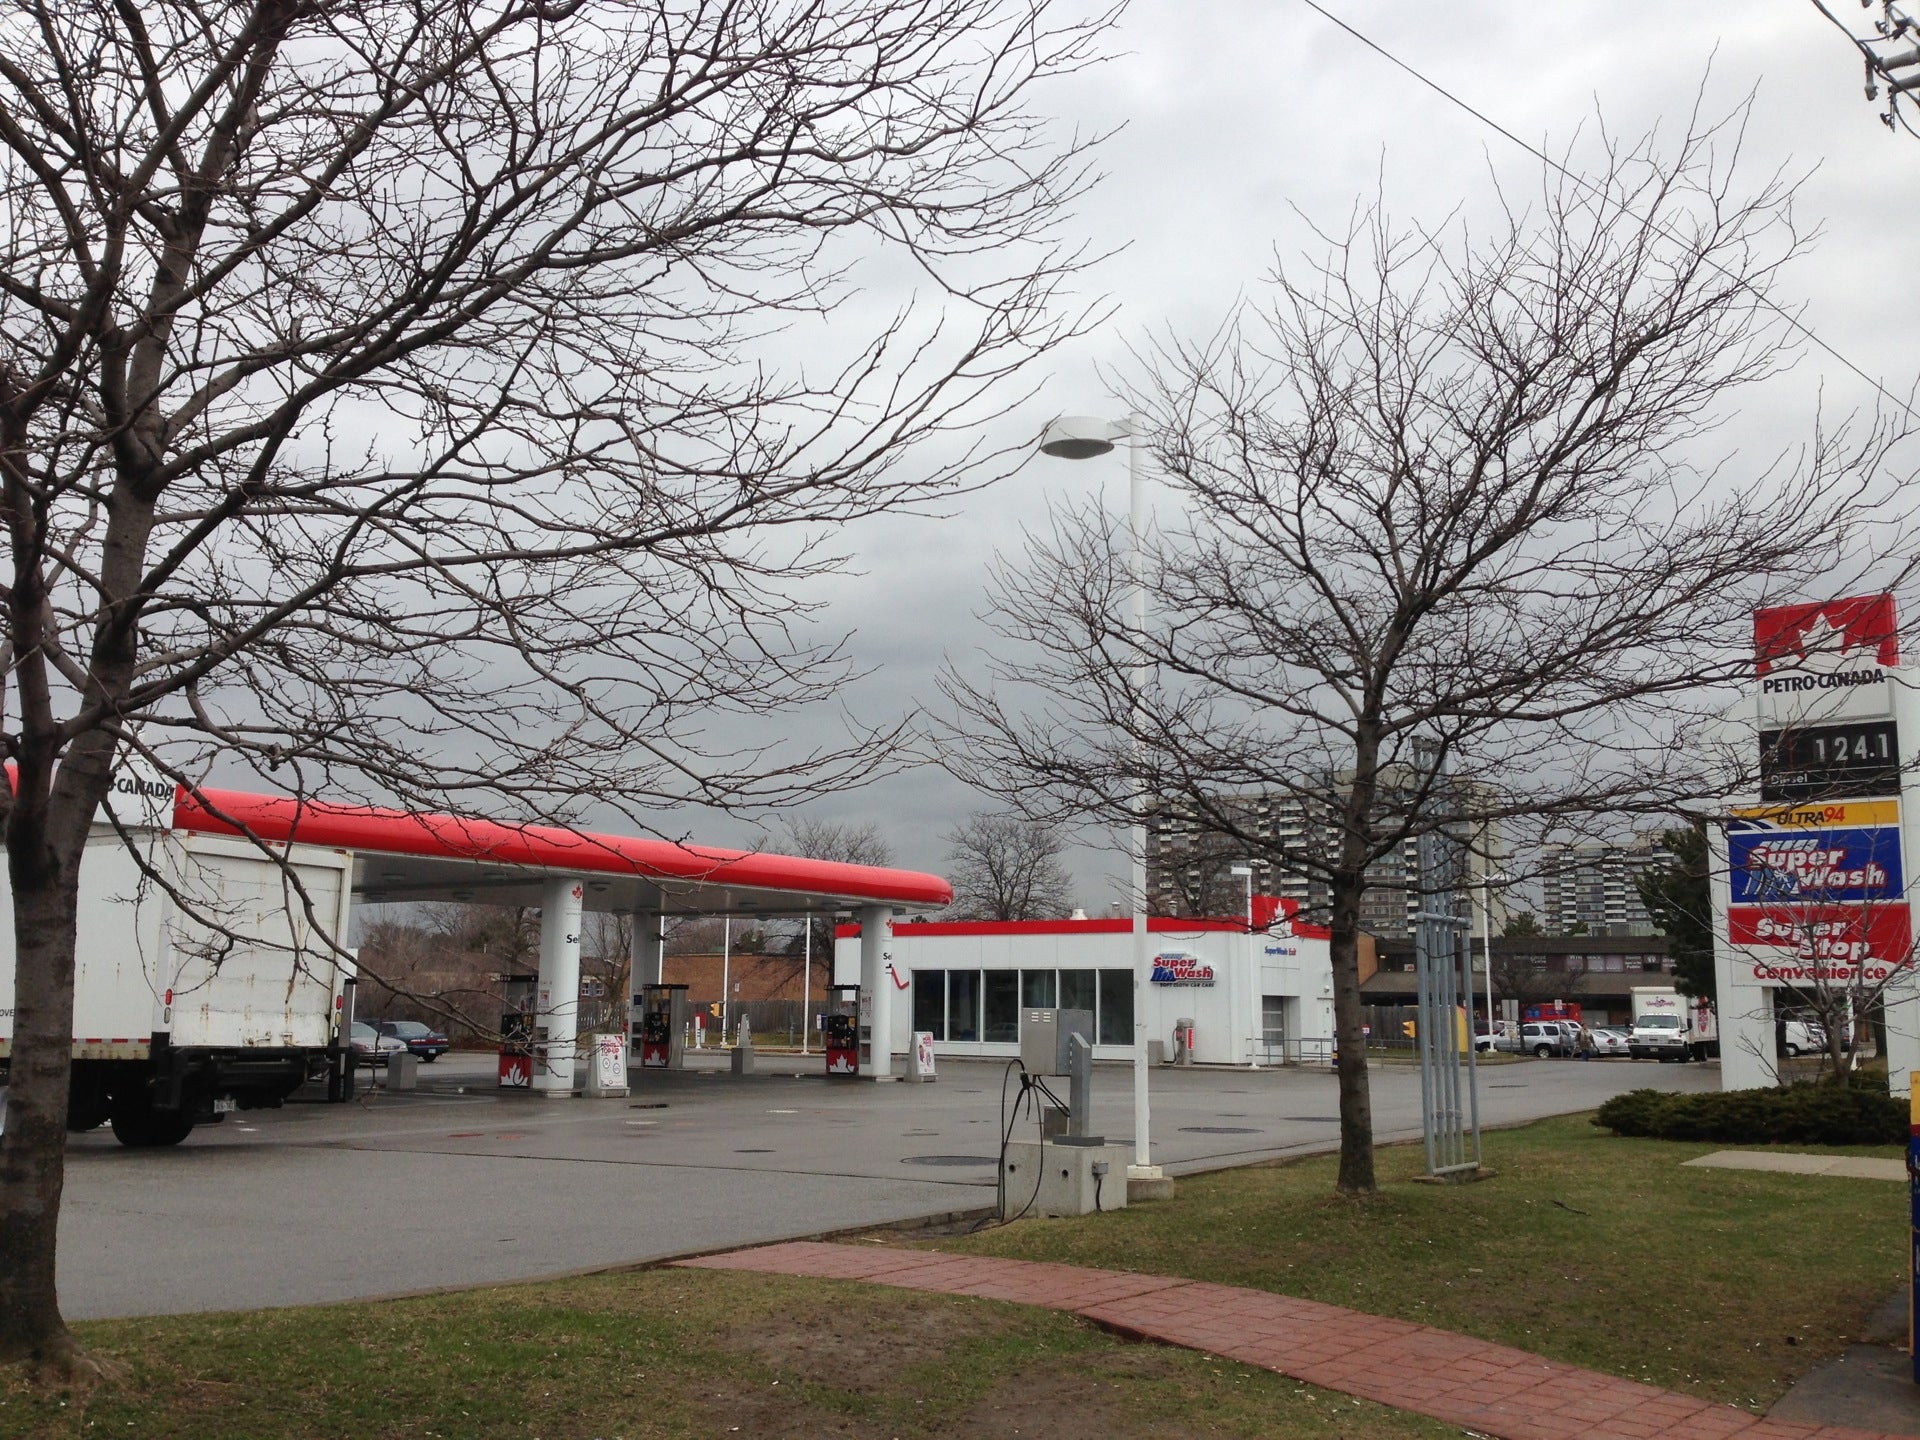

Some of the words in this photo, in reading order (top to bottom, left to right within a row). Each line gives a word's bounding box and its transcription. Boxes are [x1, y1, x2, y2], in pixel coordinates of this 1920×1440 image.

[1815, 733, 1889, 762] 124.1
[1751, 847, 1844, 871] Super
[1797, 863, 1886, 887] Wash
[1756, 918, 1847, 942] Super
[1798, 940, 1871, 962] Stop
[1153, 957, 1196, 969] Super
[1174, 966, 1213, 979] Wash
[1753, 962, 1888, 980] Convenience
